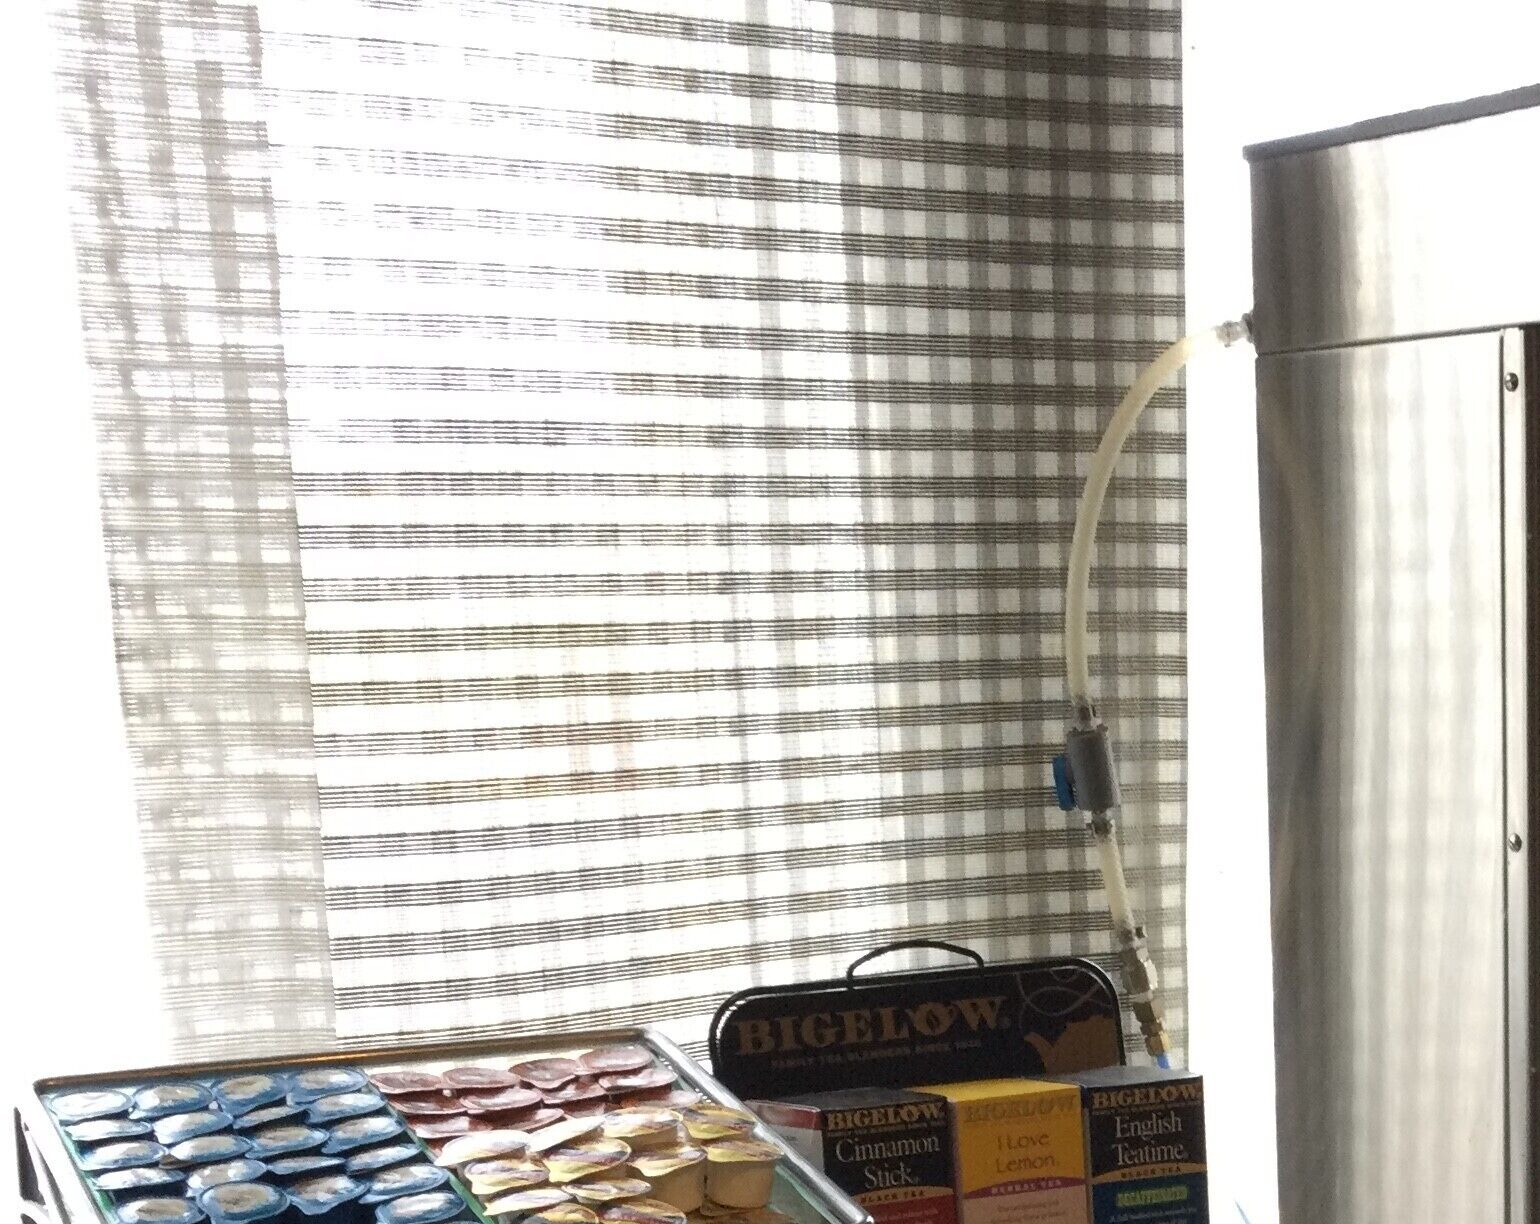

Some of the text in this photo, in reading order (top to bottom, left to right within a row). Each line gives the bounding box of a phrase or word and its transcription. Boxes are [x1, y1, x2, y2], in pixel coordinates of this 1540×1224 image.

[734, 995, 1008, 1057] BIGELOW
[1092, 1083, 1201, 1109] BIGELOW
[826, 1102, 943, 1131] BIGELOW
[1114, 1111, 1183, 1142] English
[835, 1136, 941, 1164] Cinnamon
[1006, 1132, 1051, 1151] Love
[1111, 1141, 1185, 1166] Teatime
[995, 1155, 1056, 1175] Lemon
